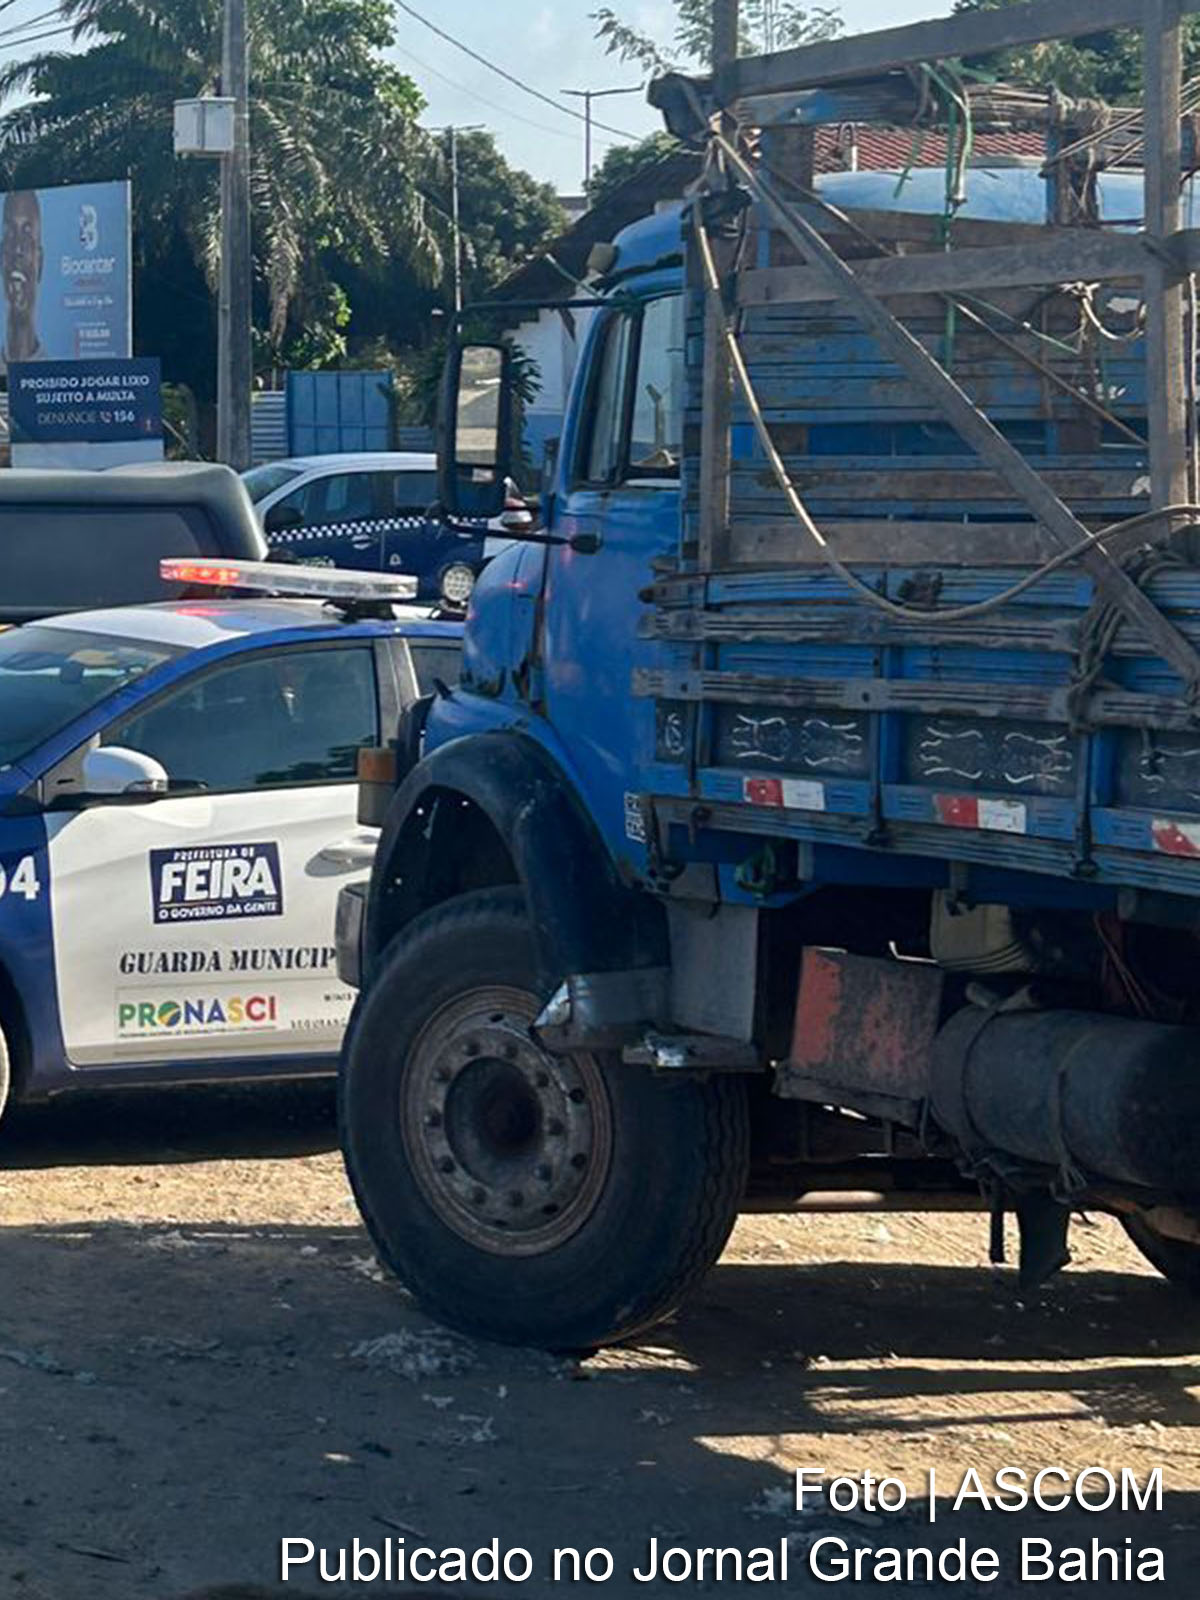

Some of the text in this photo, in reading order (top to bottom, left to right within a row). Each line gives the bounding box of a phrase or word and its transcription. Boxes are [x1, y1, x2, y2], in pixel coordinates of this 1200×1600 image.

[20, 375, 150, 389] PROIBIDO JOGAR LIXO
[35, 390, 136, 404] SUJEITO A MULTA
[174, 847, 255, 861] PREFEITURA DE
[160, 856, 278, 902] FEIRA
[158, 901, 278, 919] O GOVERNO DA GENTE
[119, 950, 223, 974] GUARDA
[118, 996, 277, 1028] PRONASCI
